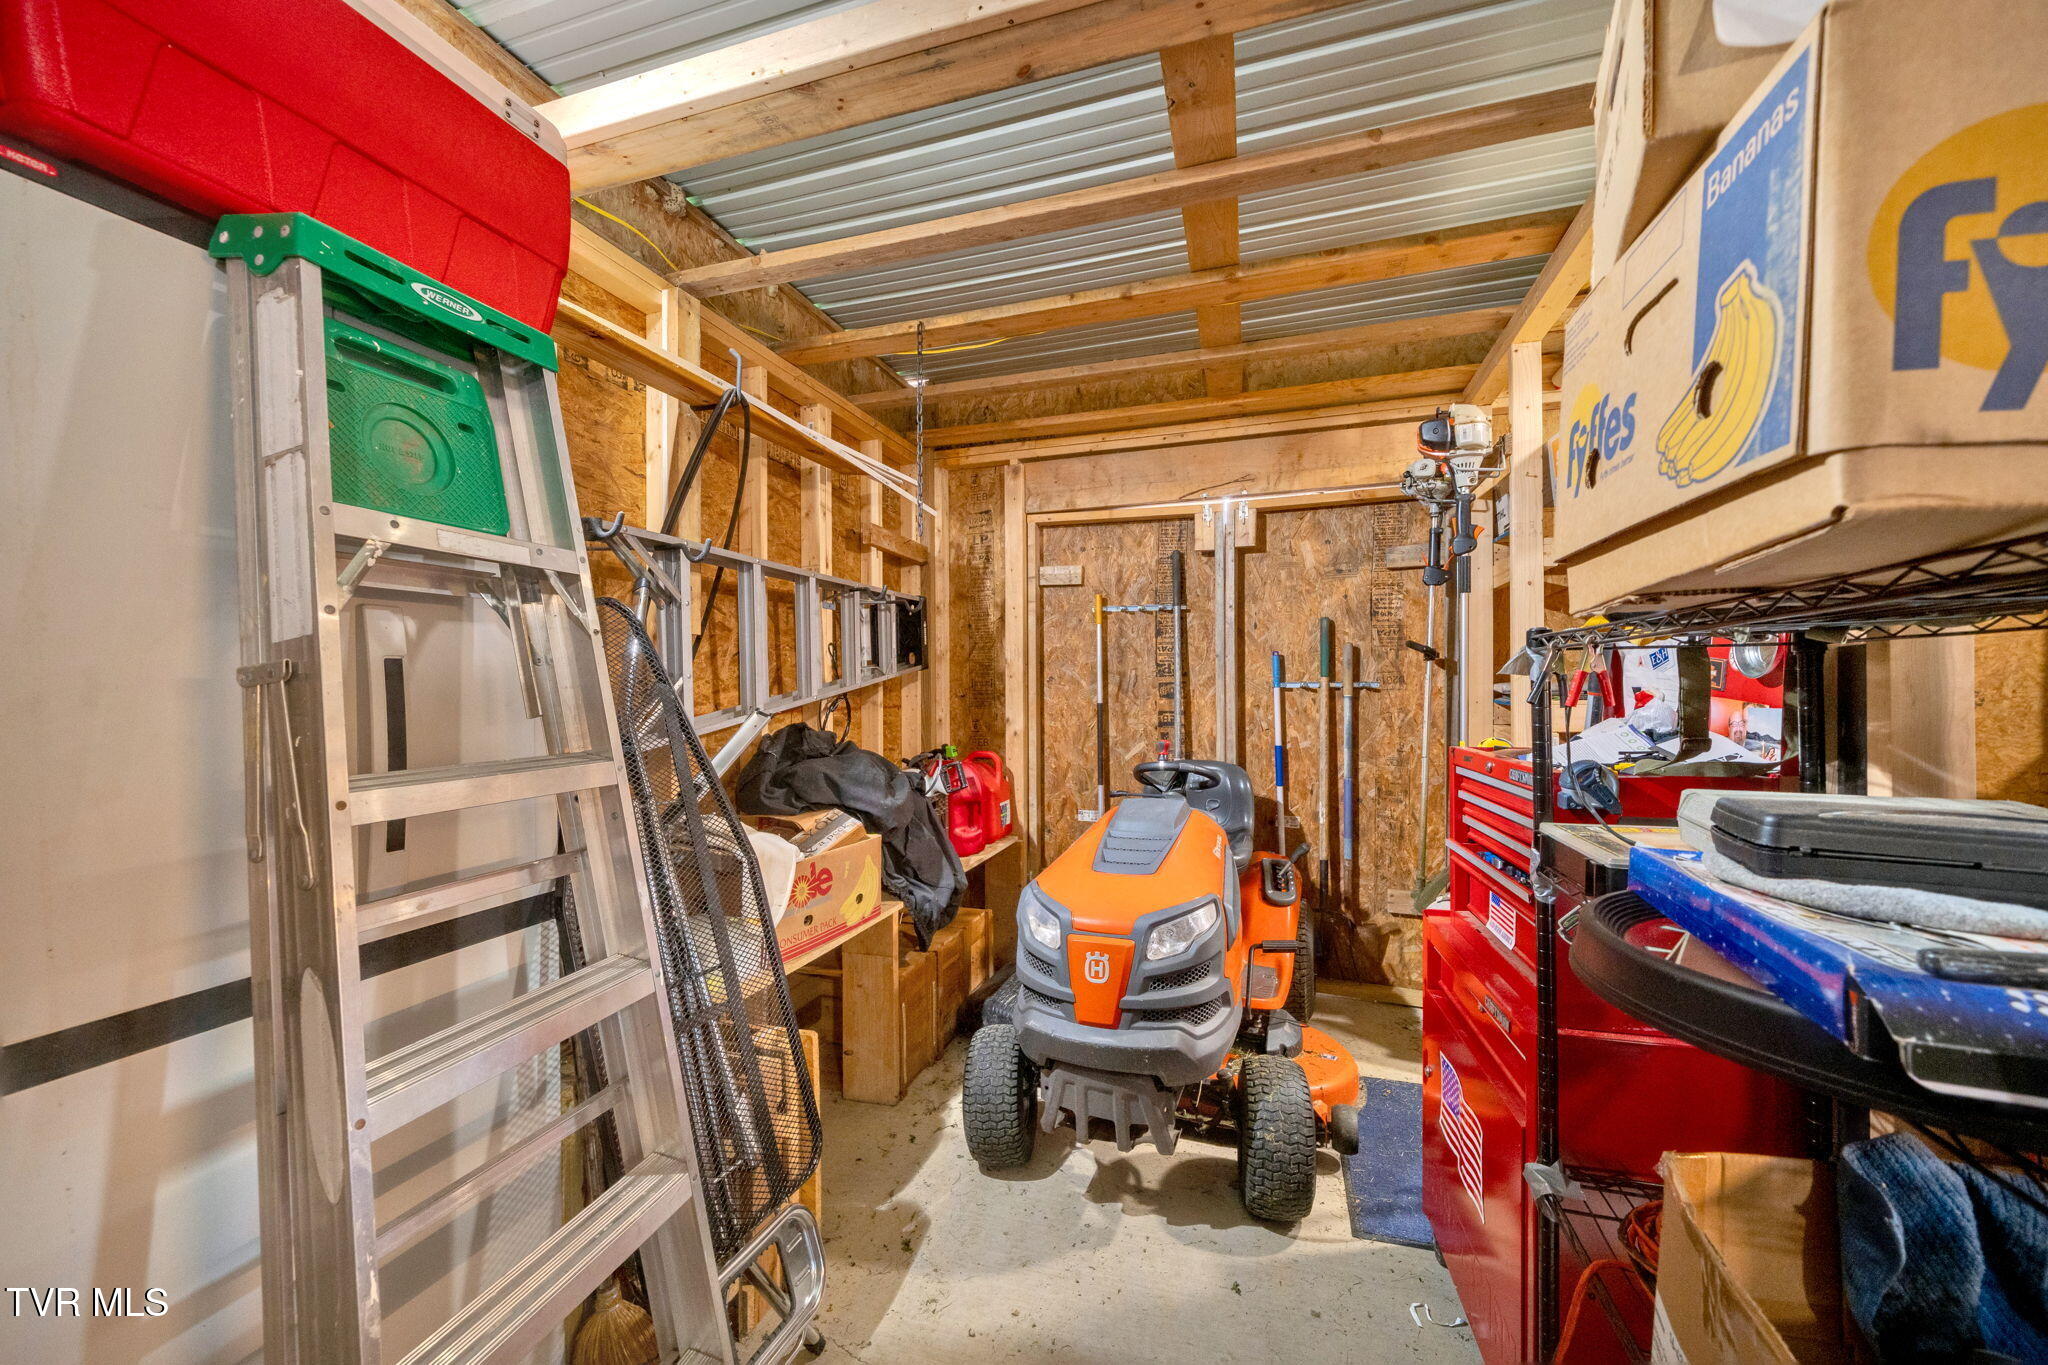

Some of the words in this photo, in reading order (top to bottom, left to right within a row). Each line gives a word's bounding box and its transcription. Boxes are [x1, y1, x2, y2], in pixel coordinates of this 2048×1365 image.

[1707, 86, 1799, 211] Bananas
[425, 288, 470, 315] WERNER
[1567, 393, 1637, 498] fyffes
[780, 926, 818, 948] ONSUMER
[820, 916, 838, 932] PACK
